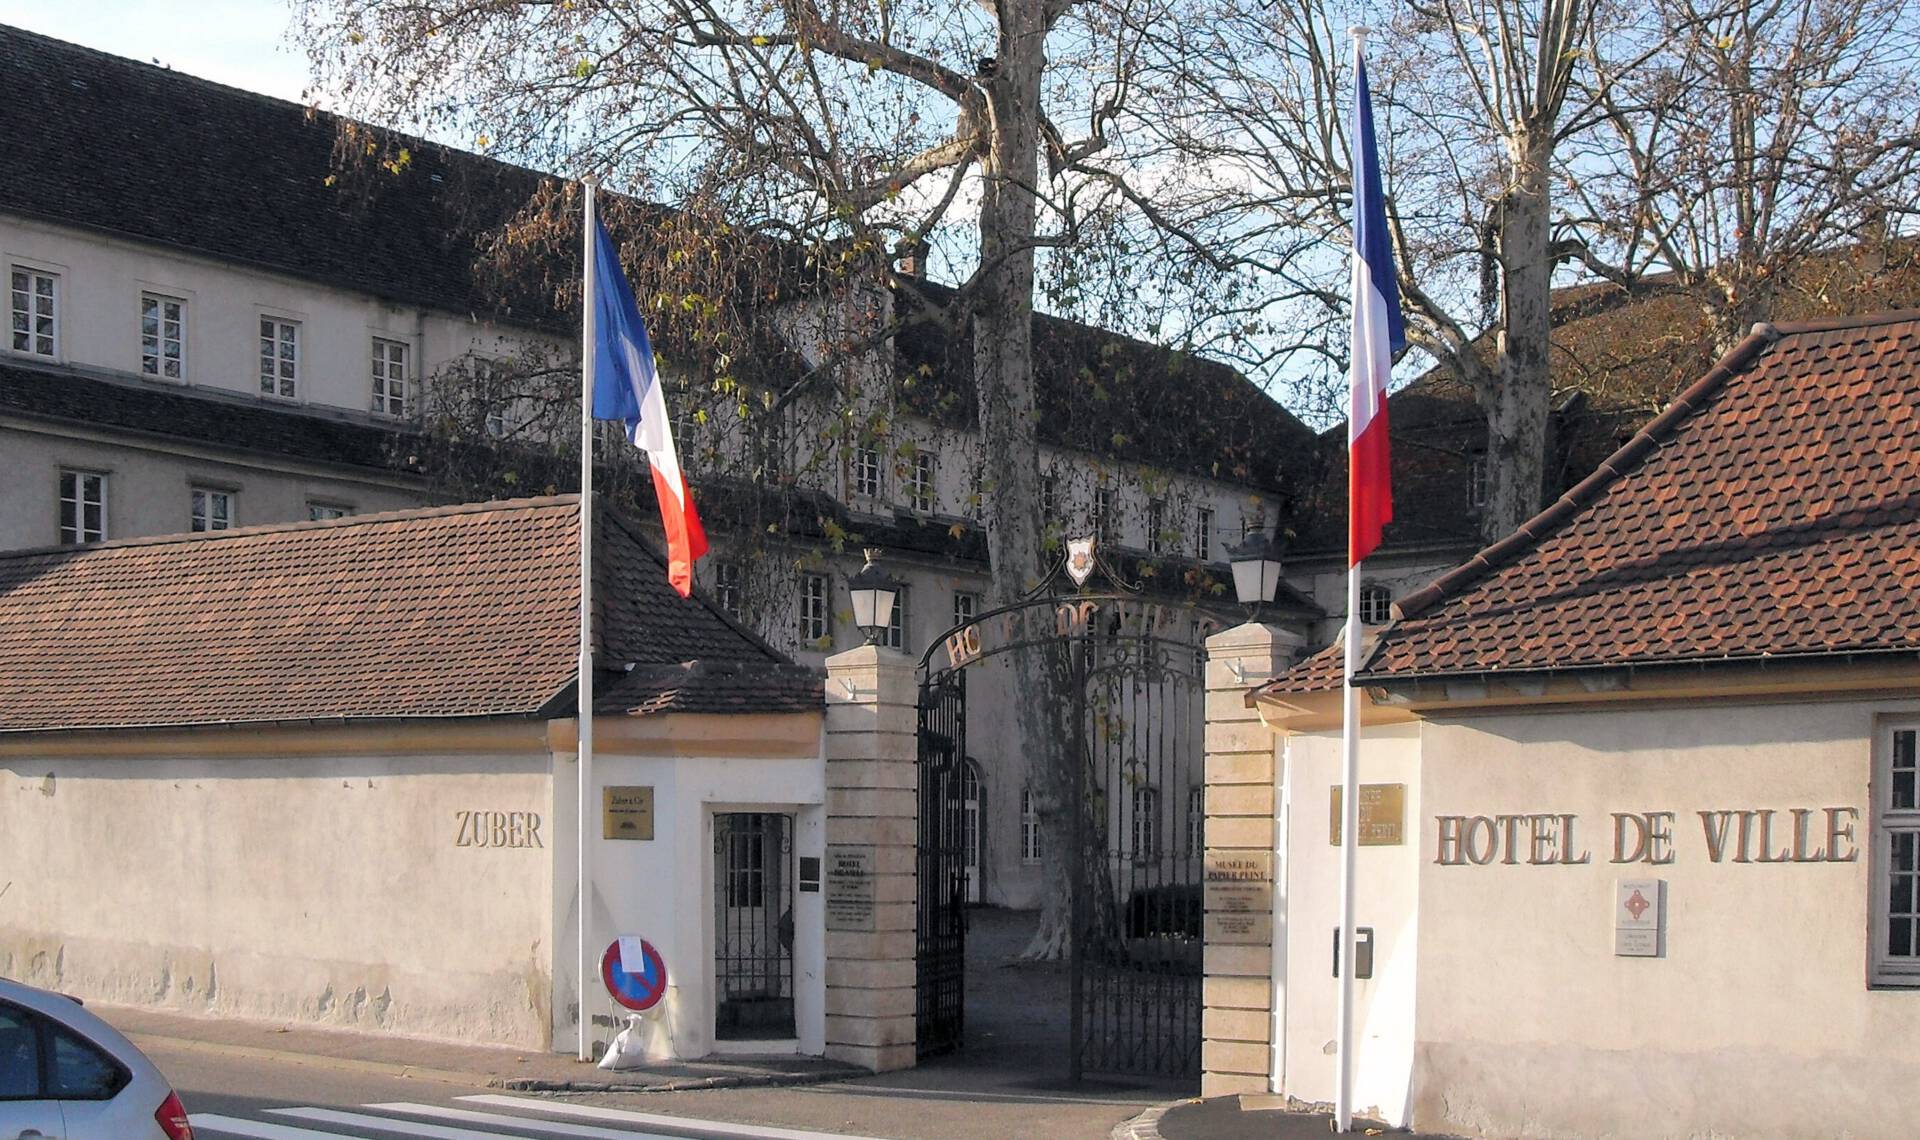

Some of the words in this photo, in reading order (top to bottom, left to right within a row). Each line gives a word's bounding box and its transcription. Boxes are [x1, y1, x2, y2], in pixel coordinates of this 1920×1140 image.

[456, 811, 544, 848] ZUBER
[1433, 813, 1591, 866] HOTEL
[1609, 811, 1676, 865] DE
[1697, 807, 1859, 863] VILLE
